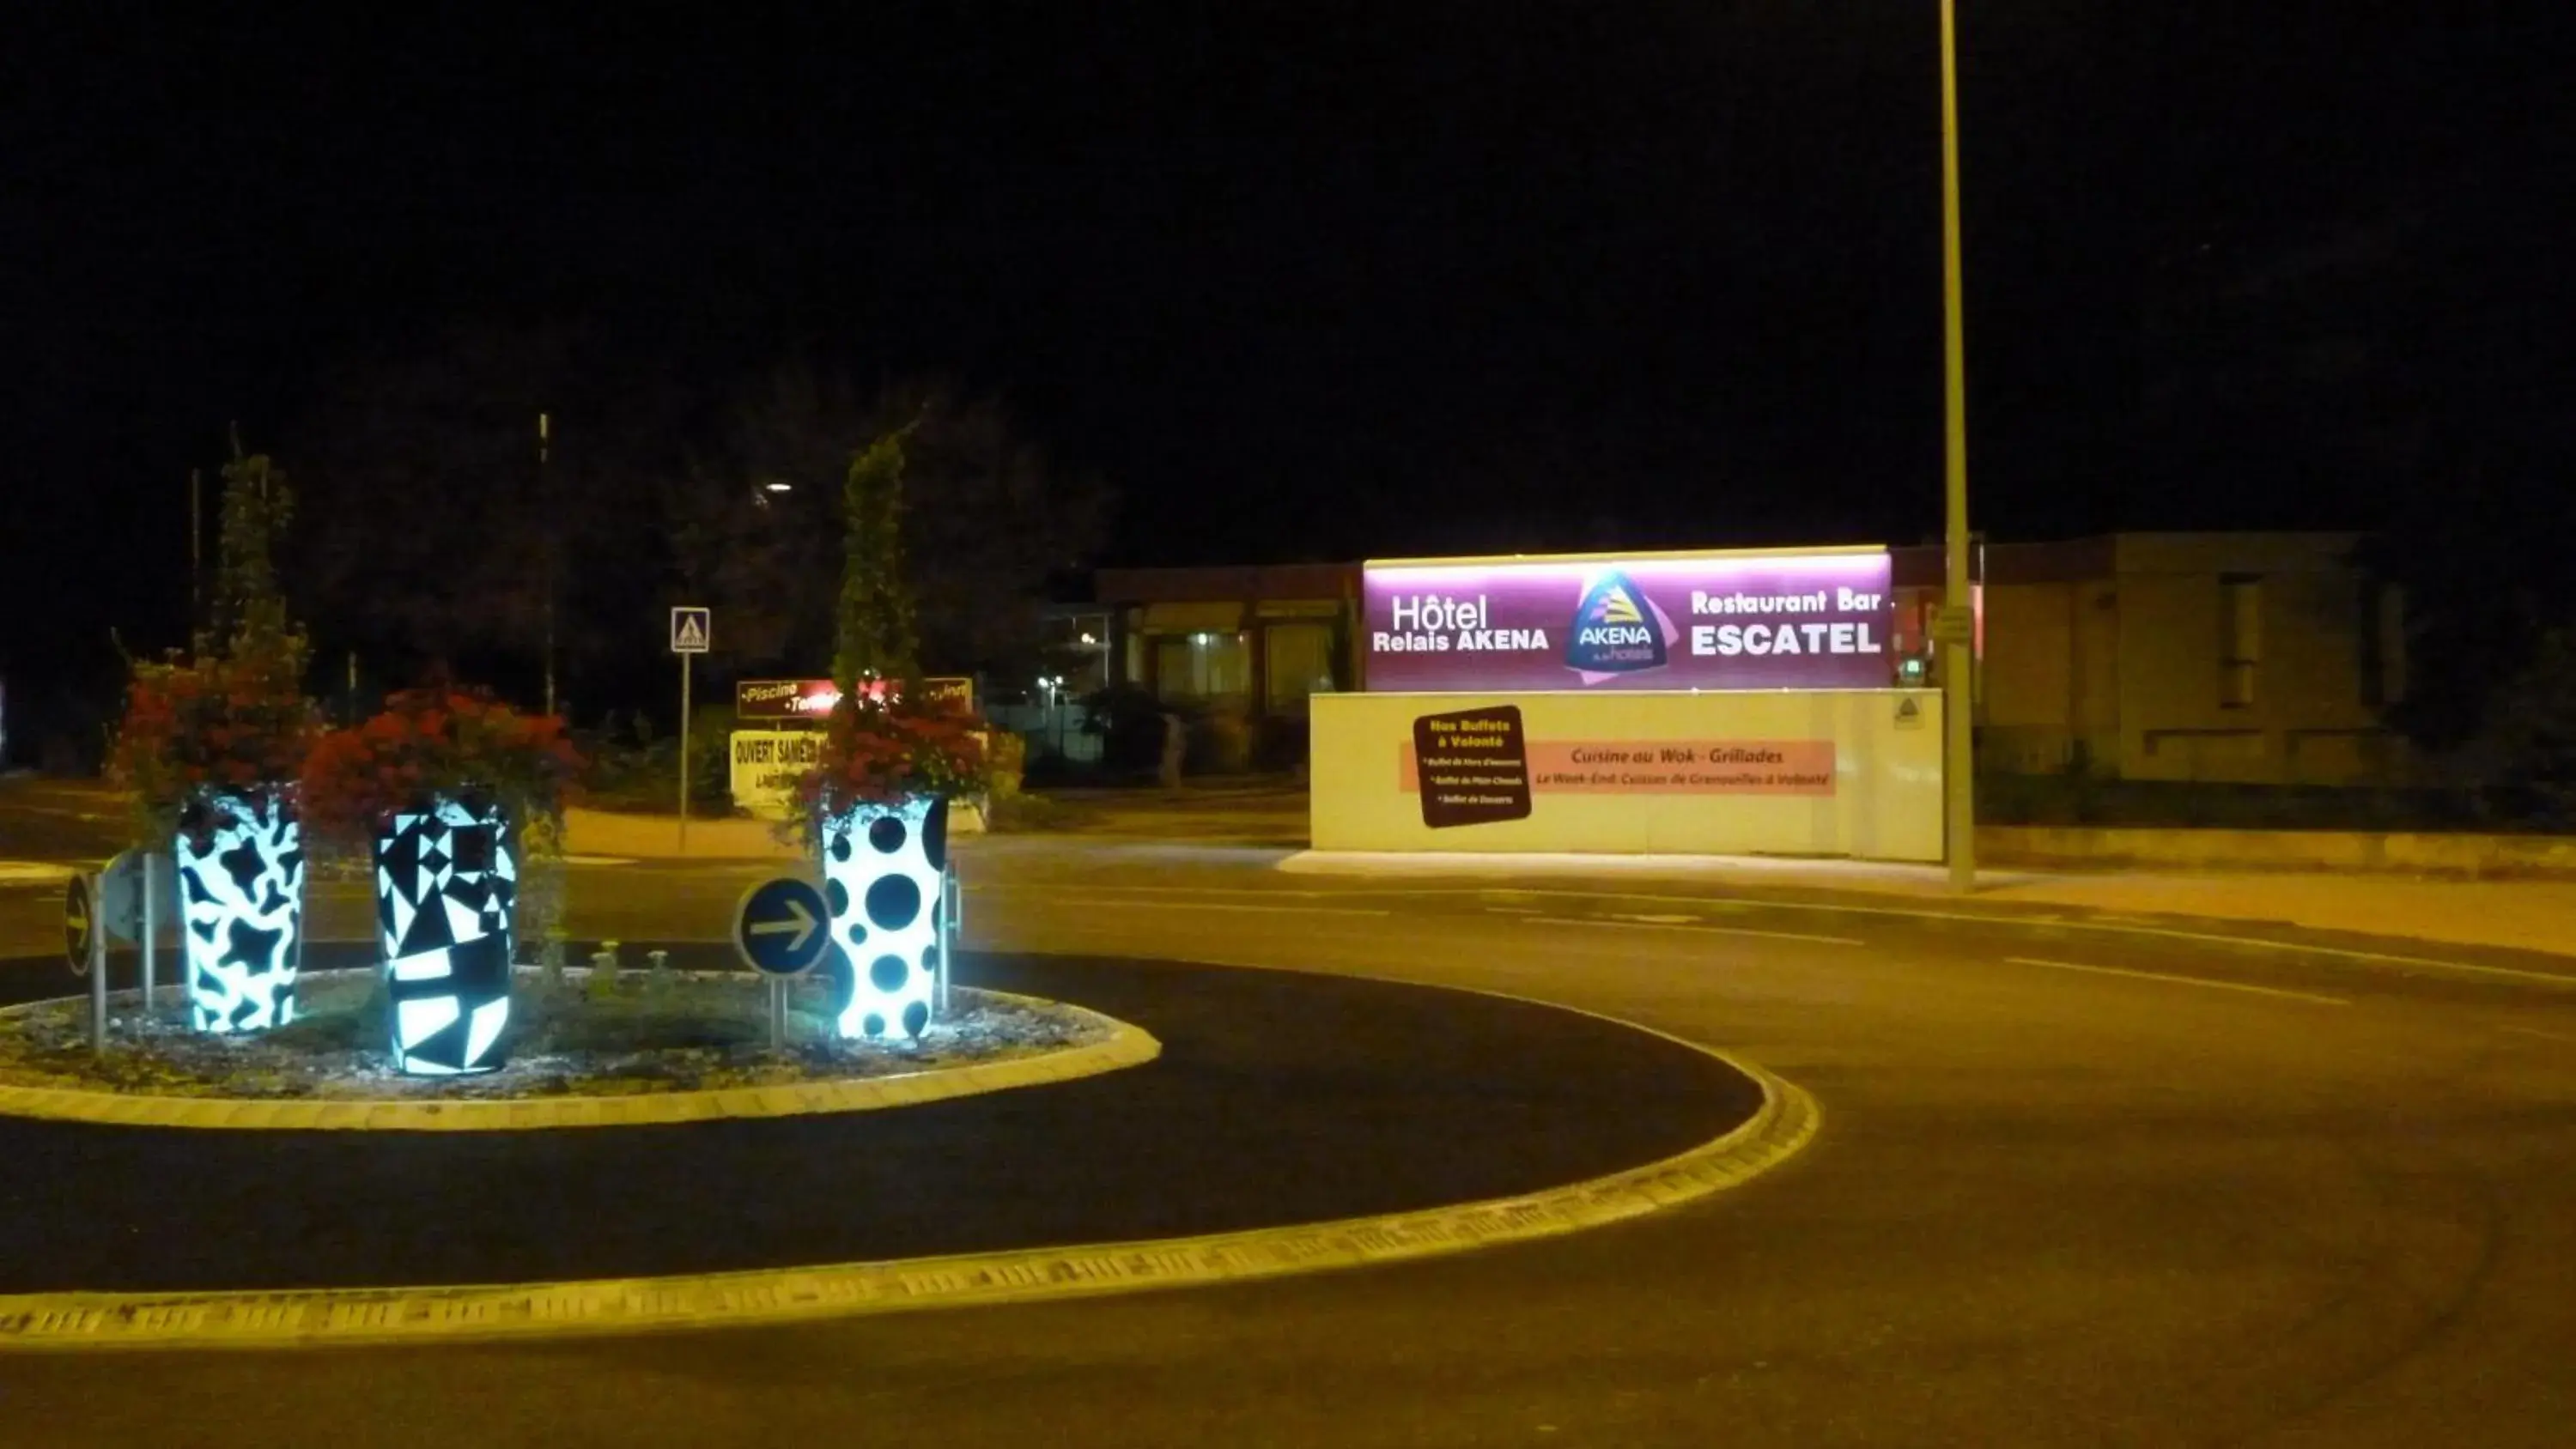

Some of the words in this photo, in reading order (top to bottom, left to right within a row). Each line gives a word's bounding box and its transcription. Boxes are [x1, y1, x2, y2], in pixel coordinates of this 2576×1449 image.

[1392, 594, 1486, 630] Hôtel
[1691, 590, 1827, 615] Restaurant
[1837, 587, 1881, 611] Bar
[1373, 631, 1450, 652] Relais
[1456, 629, 1549, 651] AKENA
[1579, 625, 1651, 646] AKENA
[1691, 622, 1882, 655] ESCATEL
[1430, 719, 1457, 731] Nos
[1461, 719, 1510, 731] Buffets
[736, 739, 774, 764] OUVERT
[1450, 735, 1505, 748] Volonté
[1571, 749, 1629, 764] Cuisine
[1632, 752, 1654, 763] au
[1660, 749, 1695, 763] Wok
[1709, 748, 1784, 764] Grillades
